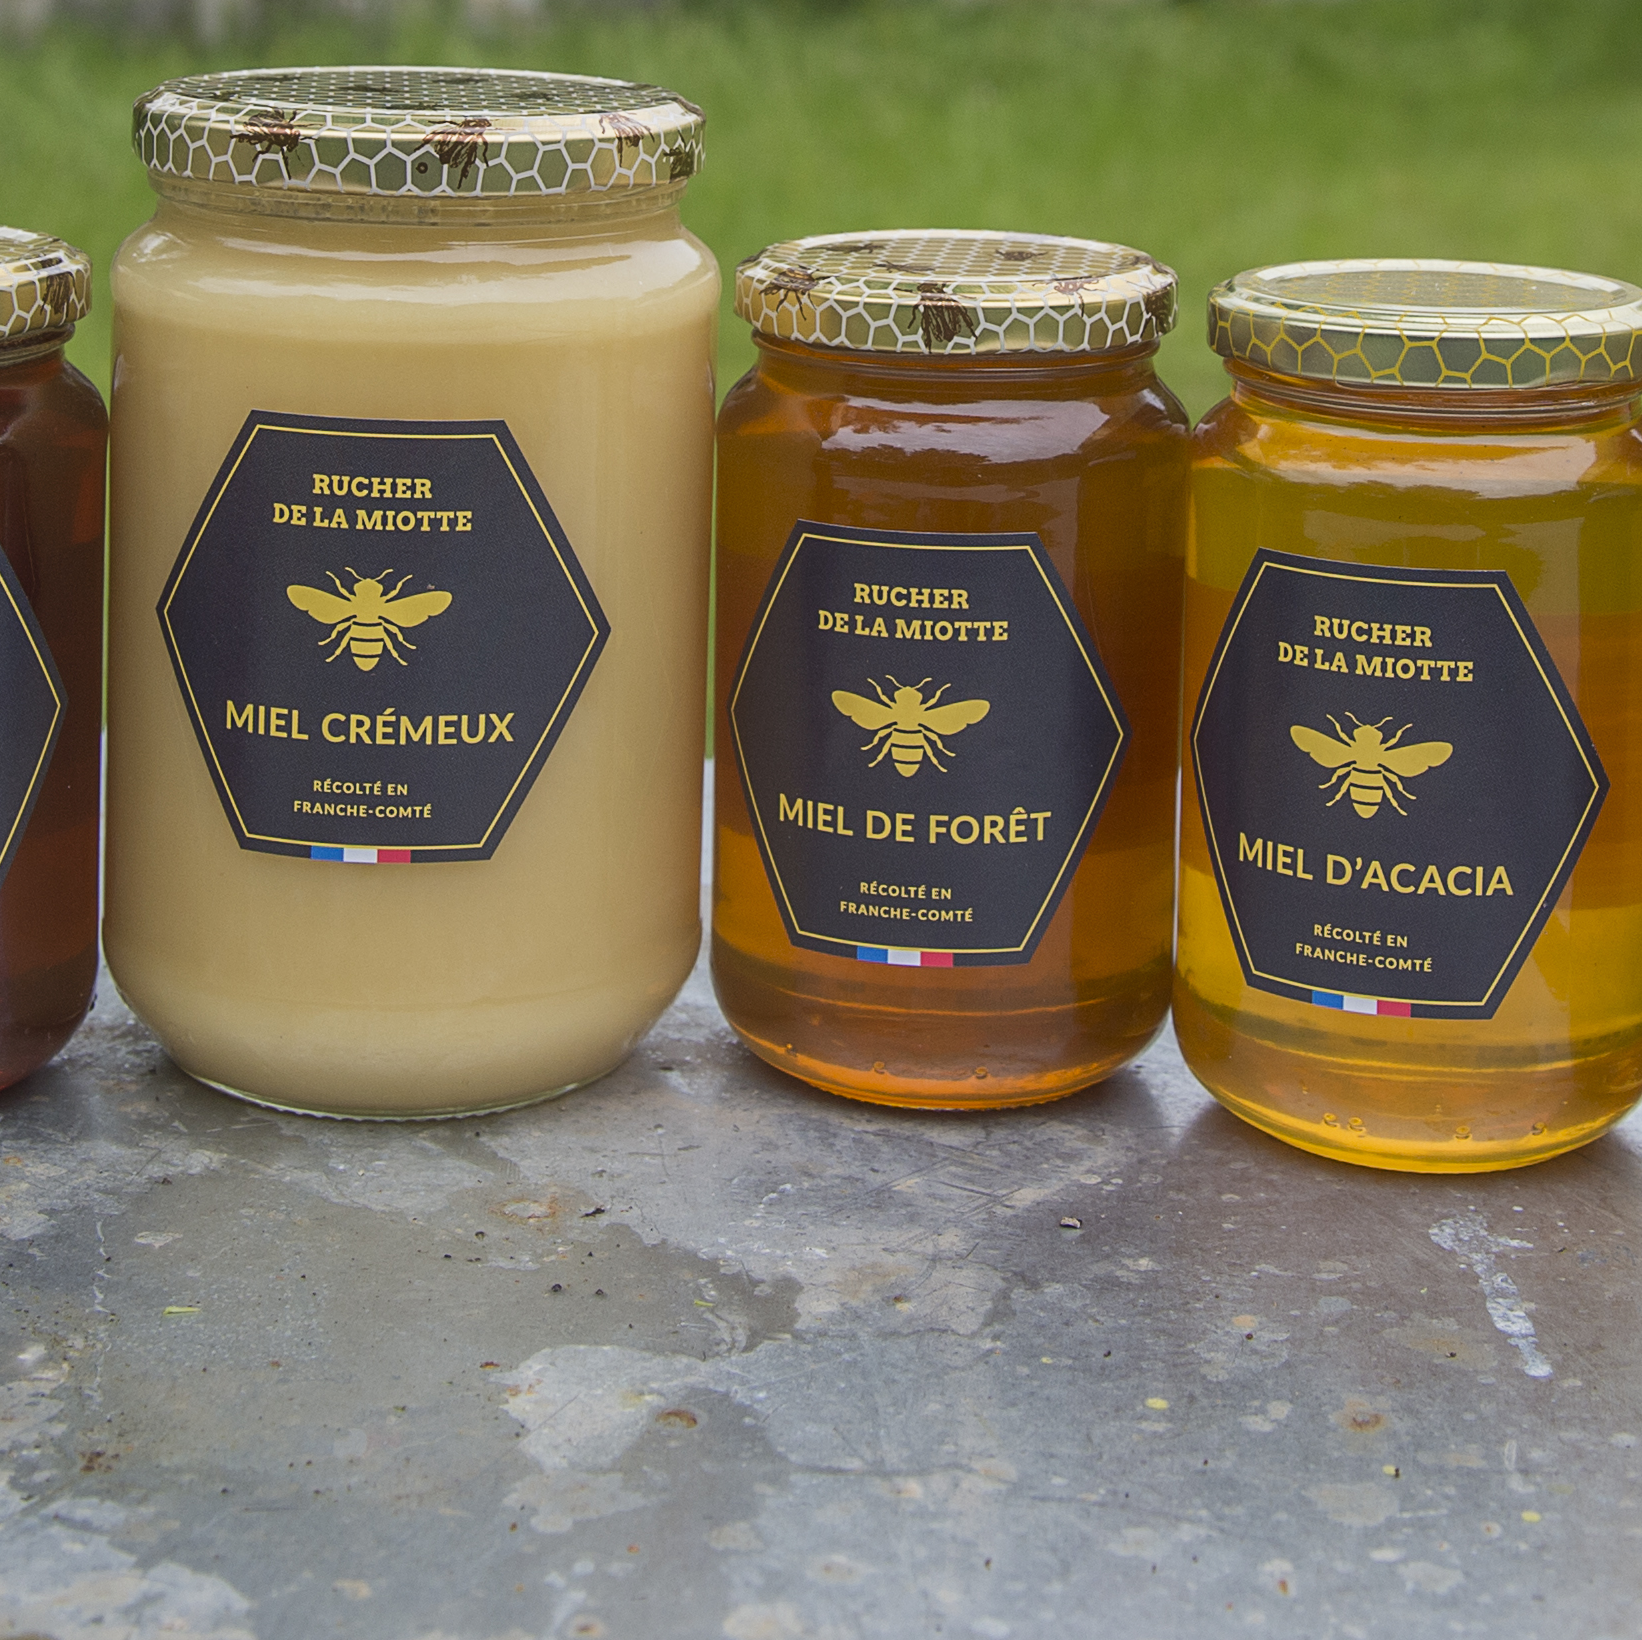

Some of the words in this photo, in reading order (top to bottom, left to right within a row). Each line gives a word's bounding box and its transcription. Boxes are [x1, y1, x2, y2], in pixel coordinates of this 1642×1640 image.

[312, 473, 433, 499] RUCHER
[273, 502, 307, 526] DE
[313, 506, 349, 529] LA
[355, 509, 473, 532] MIOTTE
[853, 582, 969, 610] RUCHER
[818, 609, 849, 633] DE
[854, 614, 889, 638] LA
[894, 618, 1009, 642] MIOTTE
[1313, 614, 1432, 648] RUCHER
[1277, 641, 1309, 667] DE
[1314, 648, 1349, 673] LA
[1355, 654, 1474, 682] MIOTTE
[226, 699, 309, 740] MIEL
[321, 707, 515, 745] CRÉMEUX
[312, 778, 382, 796] RÉCOLTÉ
[387, 783, 409, 796] EN
[293, 799, 432, 818] FRANCHE-COMTÉ
[779, 792, 854, 836] MIEL
[866, 809, 915, 843] DE
[929, 806, 1052, 845] FORÊT
[1238, 832, 1314, 880] MIEL
[859, 880, 926, 899] RÉCOLTÉ
[931, 887, 952, 900] EN
[839, 900, 973, 922] FRANCHE-COMTÉ
[1313, 923, 1381, 946] RÉCOLTÉ
[1386, 934, 1408, 948] EN
[1295, 942, 1432, 973] FRANCHE-COMTÉ
